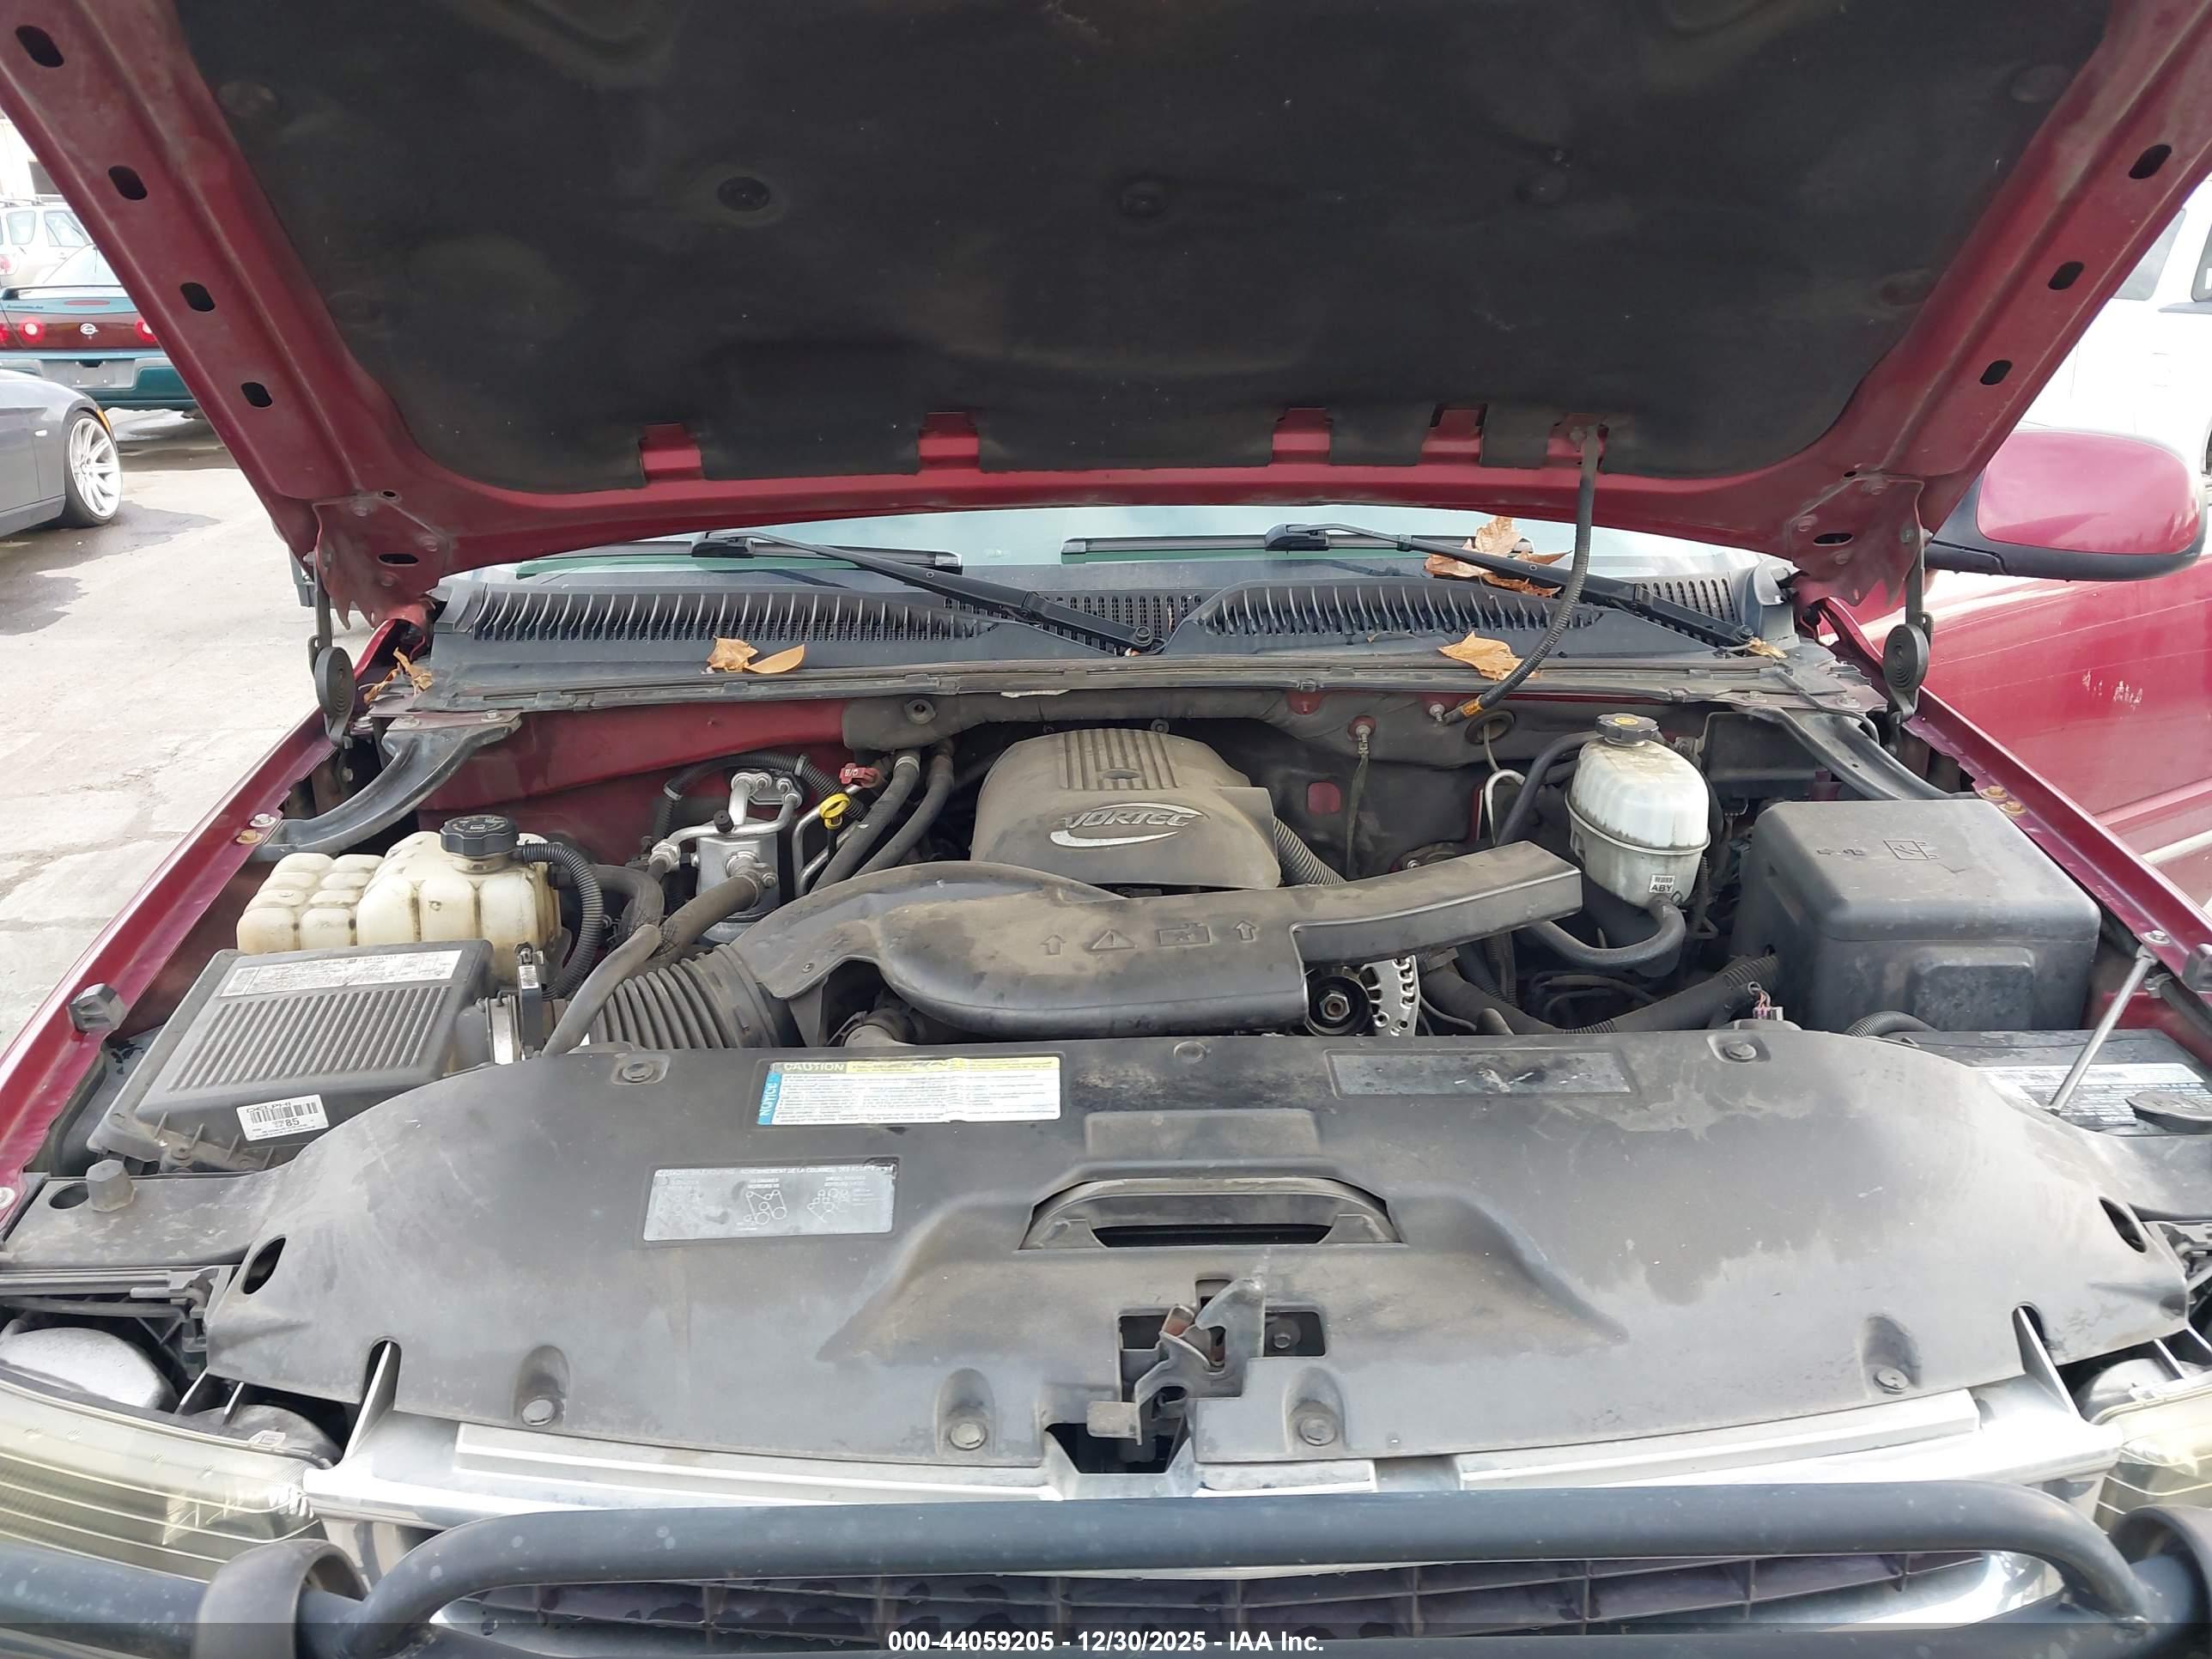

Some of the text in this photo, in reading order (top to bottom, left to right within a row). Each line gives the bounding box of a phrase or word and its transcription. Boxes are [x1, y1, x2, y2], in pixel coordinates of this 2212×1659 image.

[1062, 808, 1198, 829] VORTEC
[783, 1062, 844, 1072] CAUTION
[285, 1117, 300, 1127] 85
